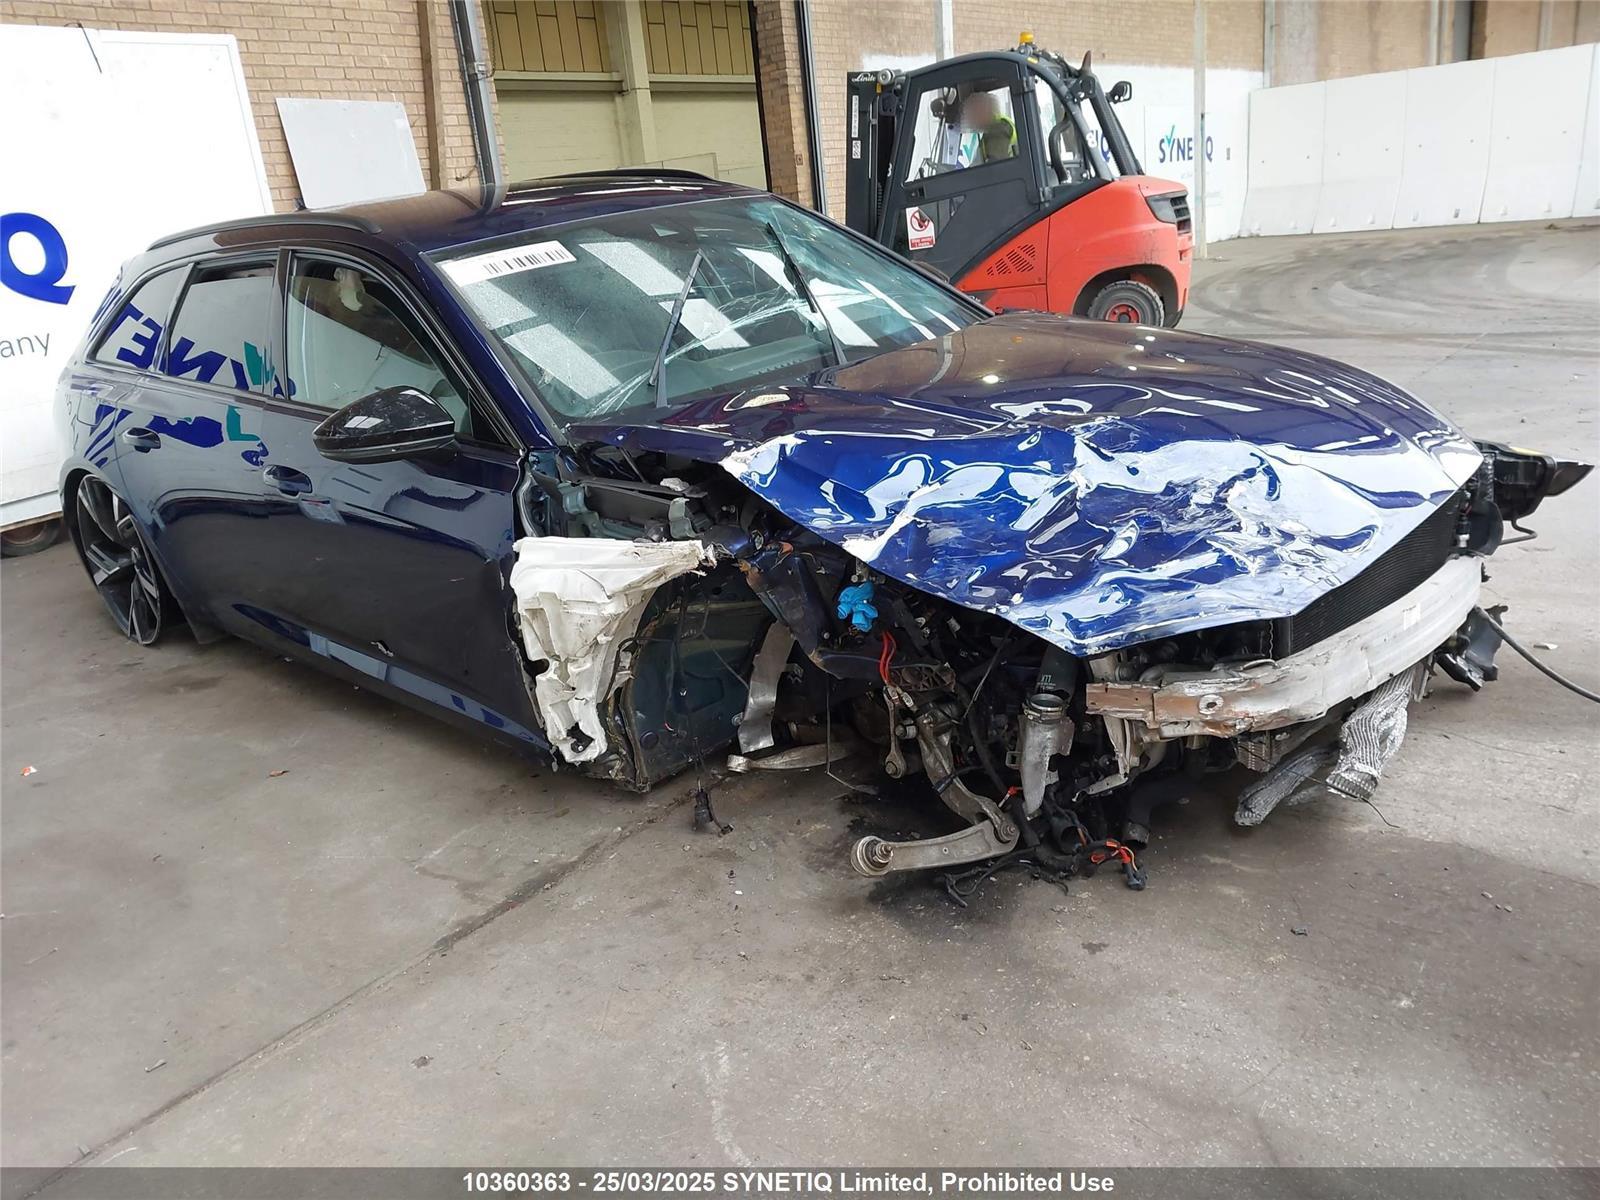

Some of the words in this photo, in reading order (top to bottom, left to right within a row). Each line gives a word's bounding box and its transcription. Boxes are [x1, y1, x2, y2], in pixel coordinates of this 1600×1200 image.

[852, 72, 877, 82] Linde
[1158, 125, 1213, 163] SYNEQ
[0, 212, 76, 305] Q
